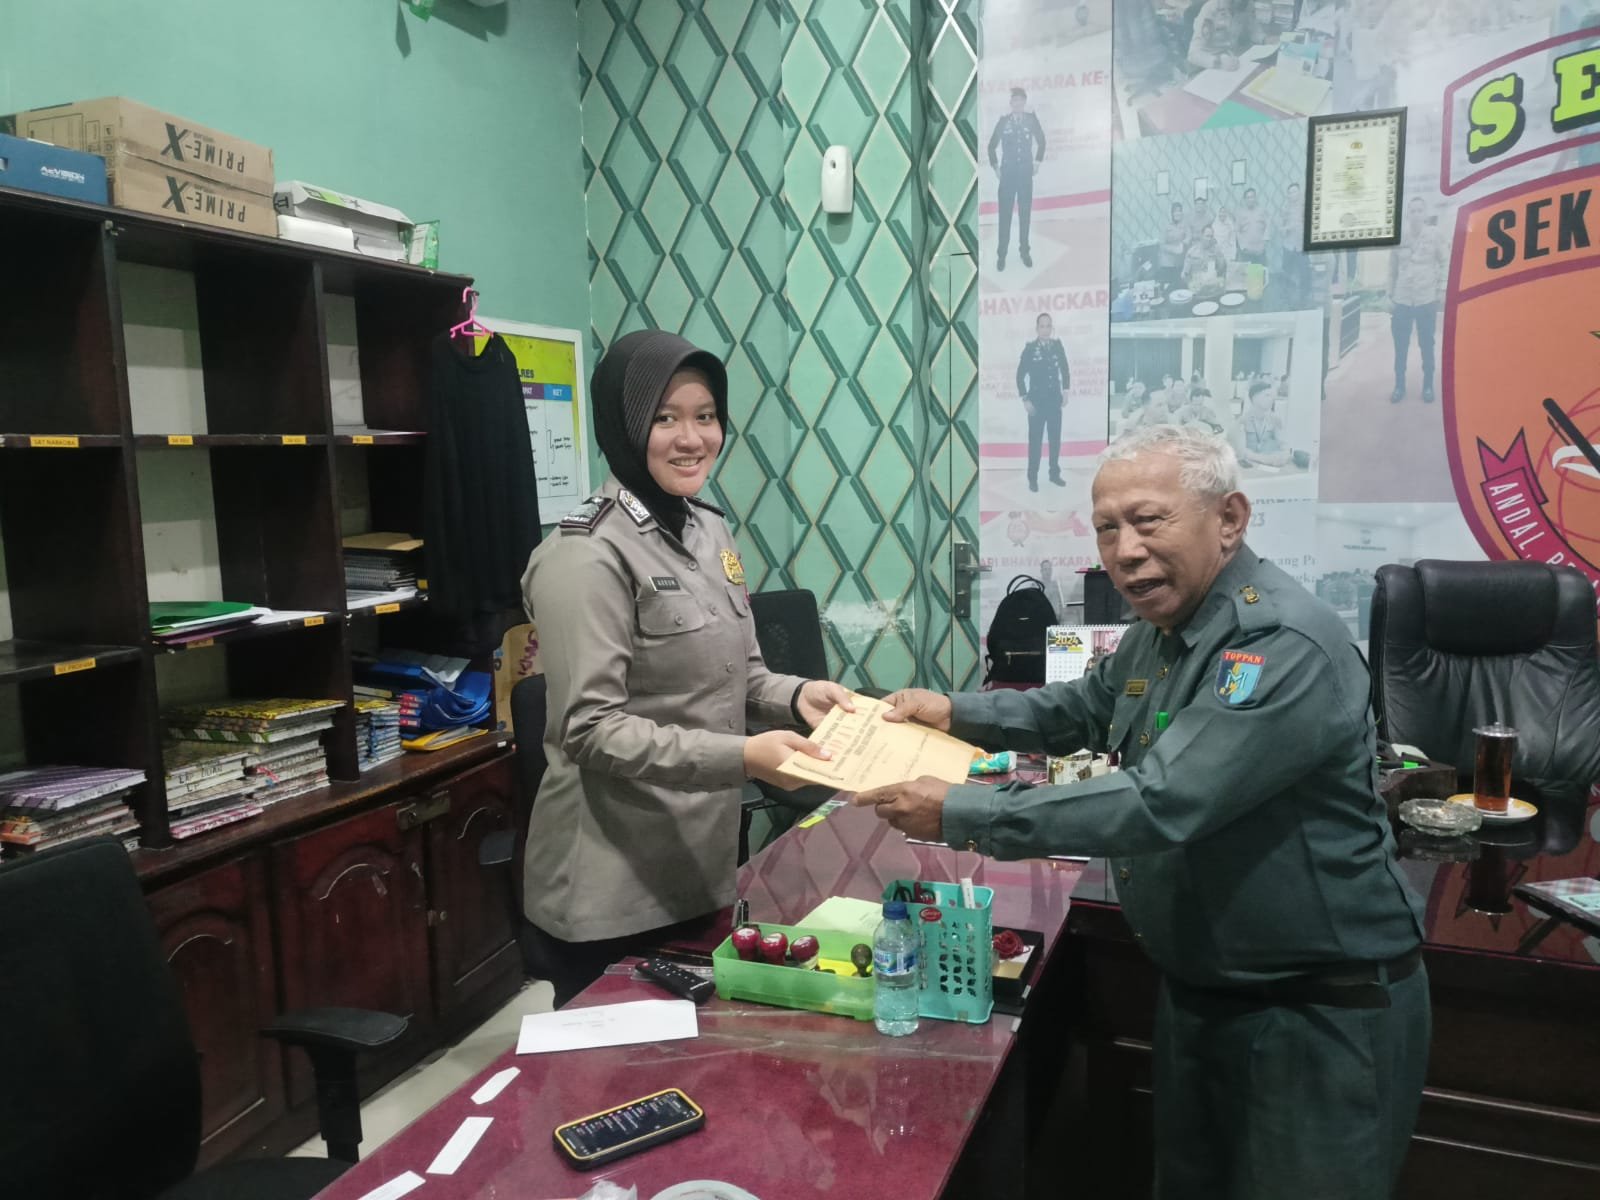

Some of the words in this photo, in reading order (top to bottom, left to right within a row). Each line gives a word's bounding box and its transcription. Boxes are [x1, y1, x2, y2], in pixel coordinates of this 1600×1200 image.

[161, 122, 245, 173] PRIME-X
[162, 175, 246, 222] PRIME-X
[979, 290, 1108, 316] HAYANGKAR
[1055, 635, 1079, 648] 2024
